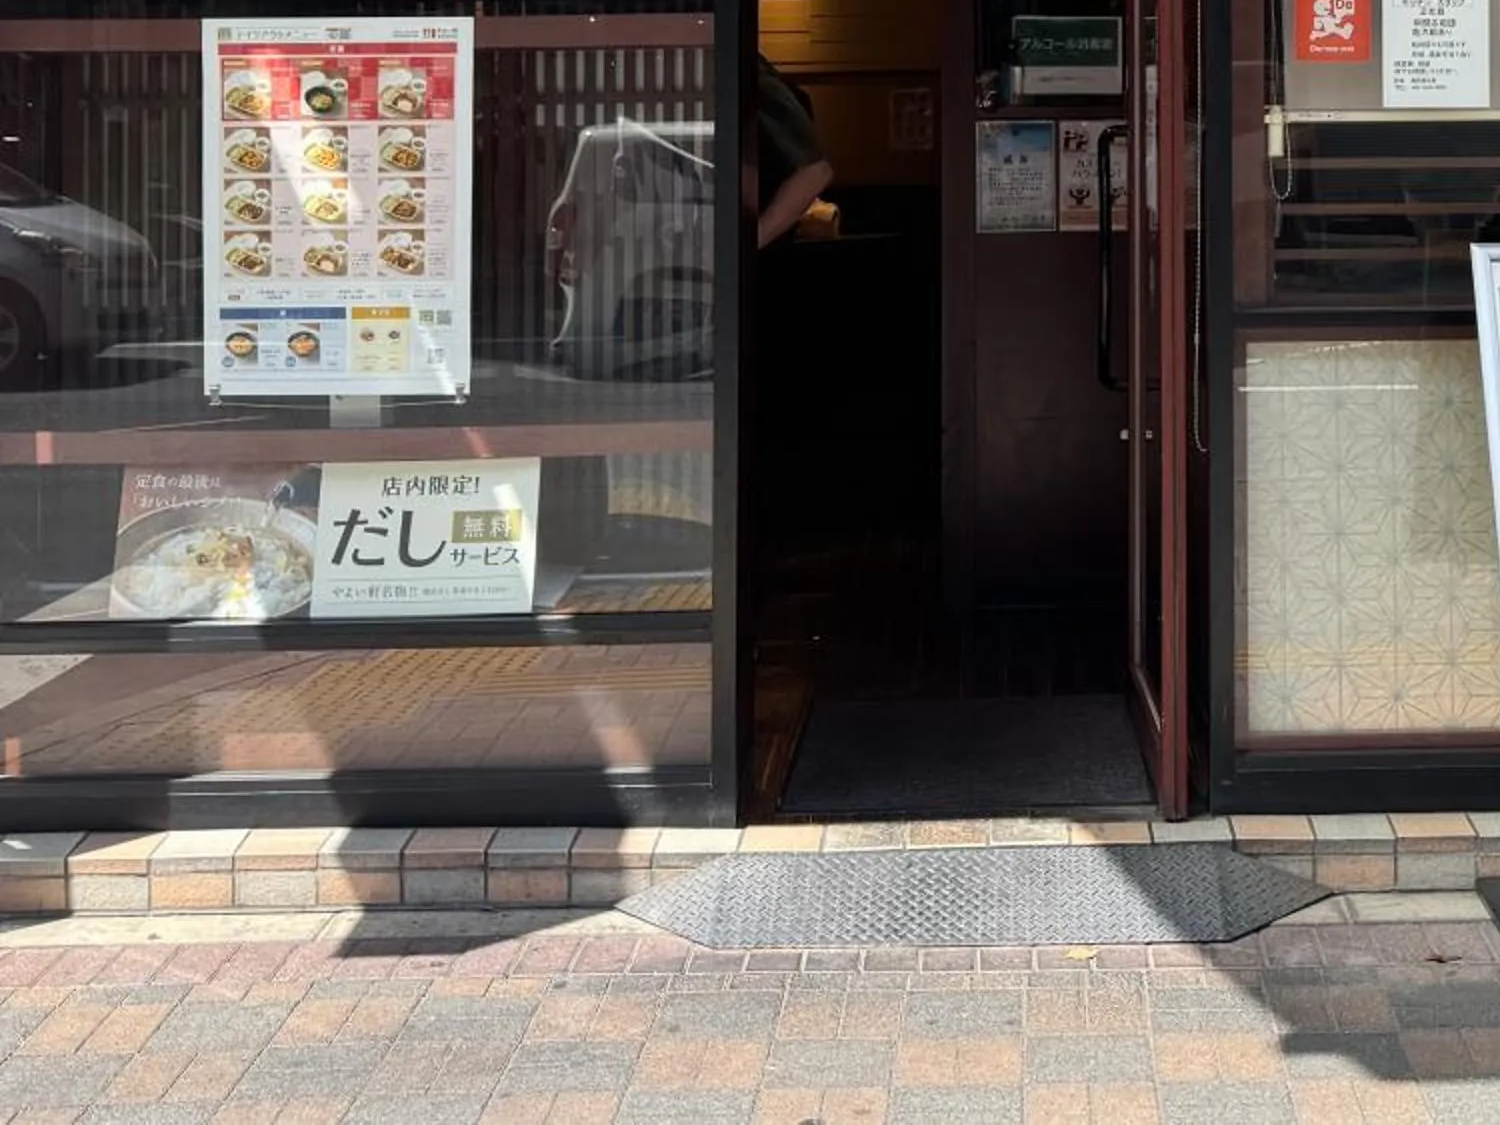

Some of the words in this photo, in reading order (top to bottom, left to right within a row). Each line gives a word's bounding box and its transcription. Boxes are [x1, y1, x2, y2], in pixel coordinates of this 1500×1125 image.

[382, 475, 480, 497] 店内限定!
[331, 506, 446, 568] だし
[462, 515, 513, 539] 無料
[450, 547, 520, 567] サービス
